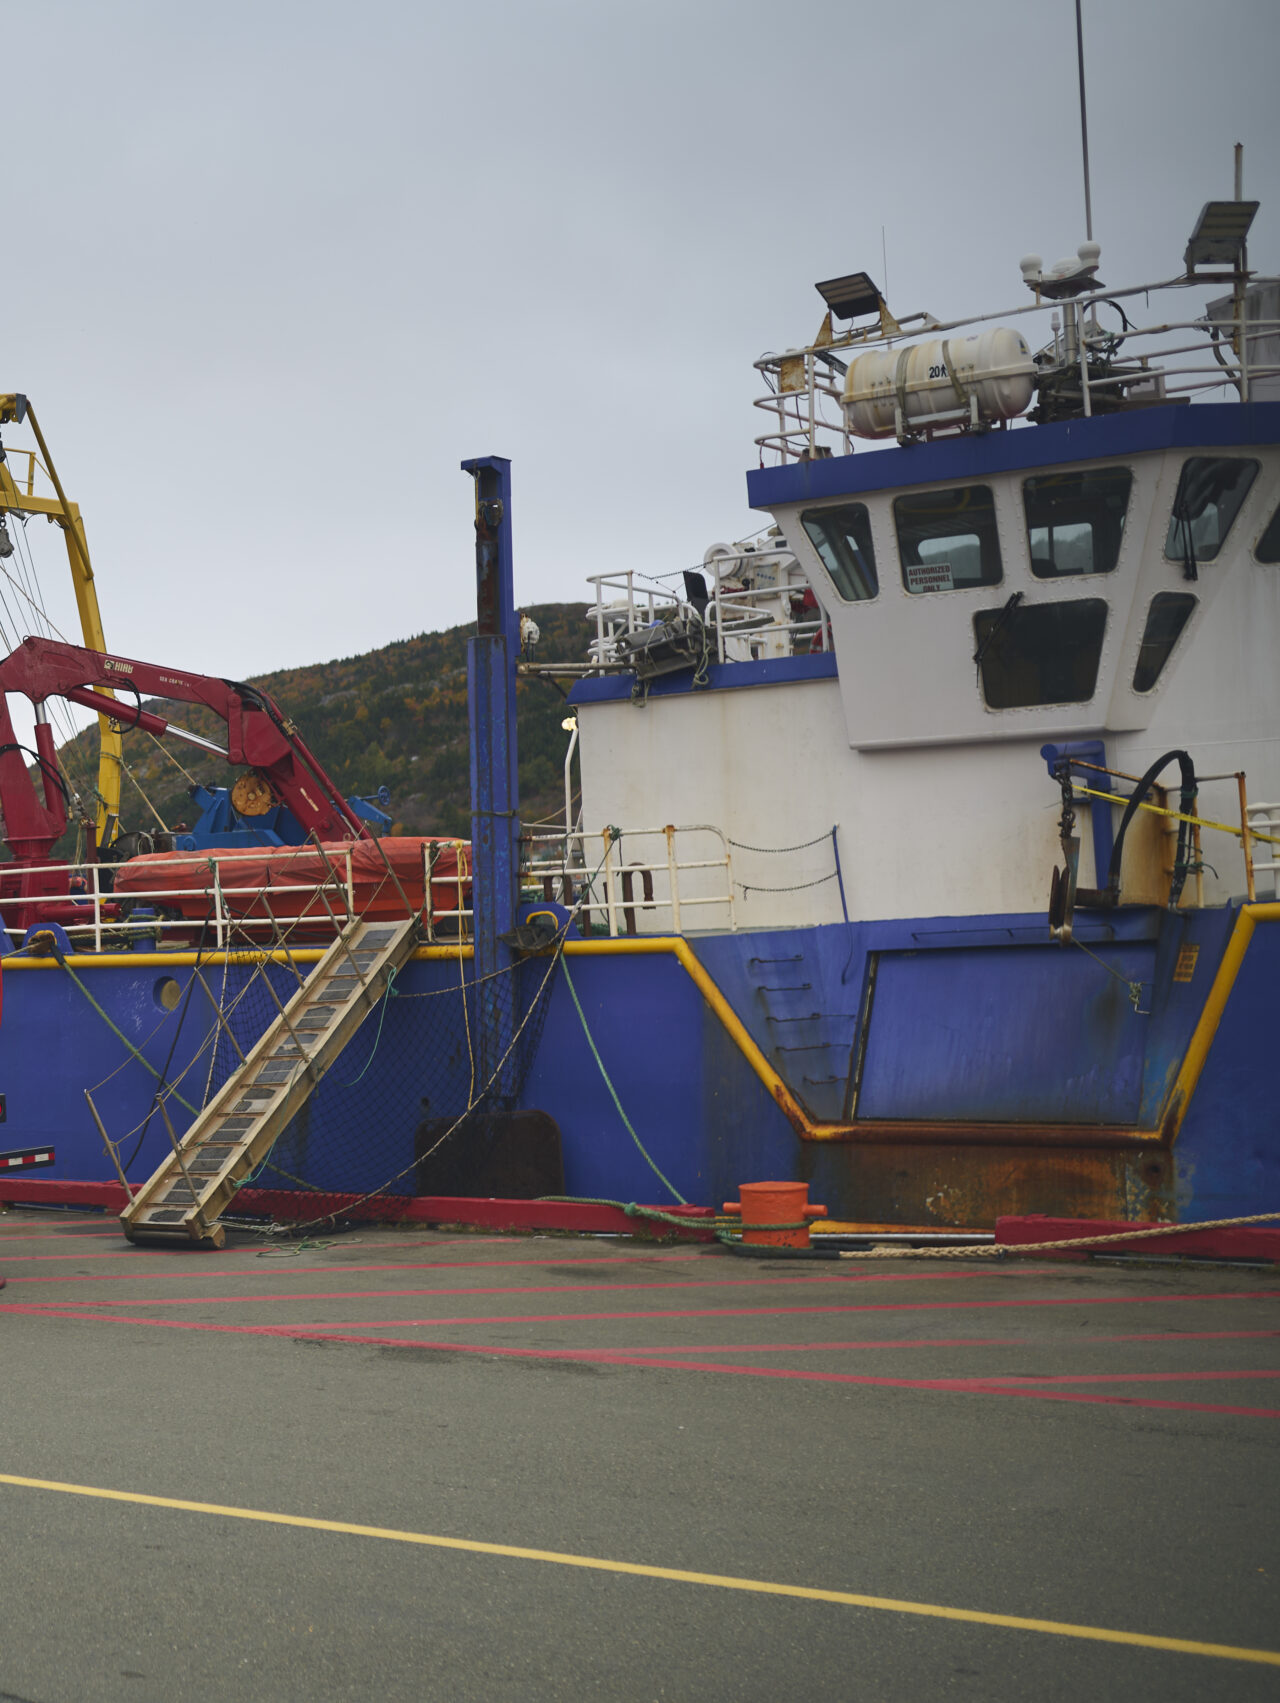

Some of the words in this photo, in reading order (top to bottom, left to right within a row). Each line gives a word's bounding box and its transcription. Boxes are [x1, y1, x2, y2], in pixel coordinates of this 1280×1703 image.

[929, 365, 940, 378] 20
[909, 565, 950, 576] AUTHORIZED
[910, 575, 950, 586] PERSONNEL
